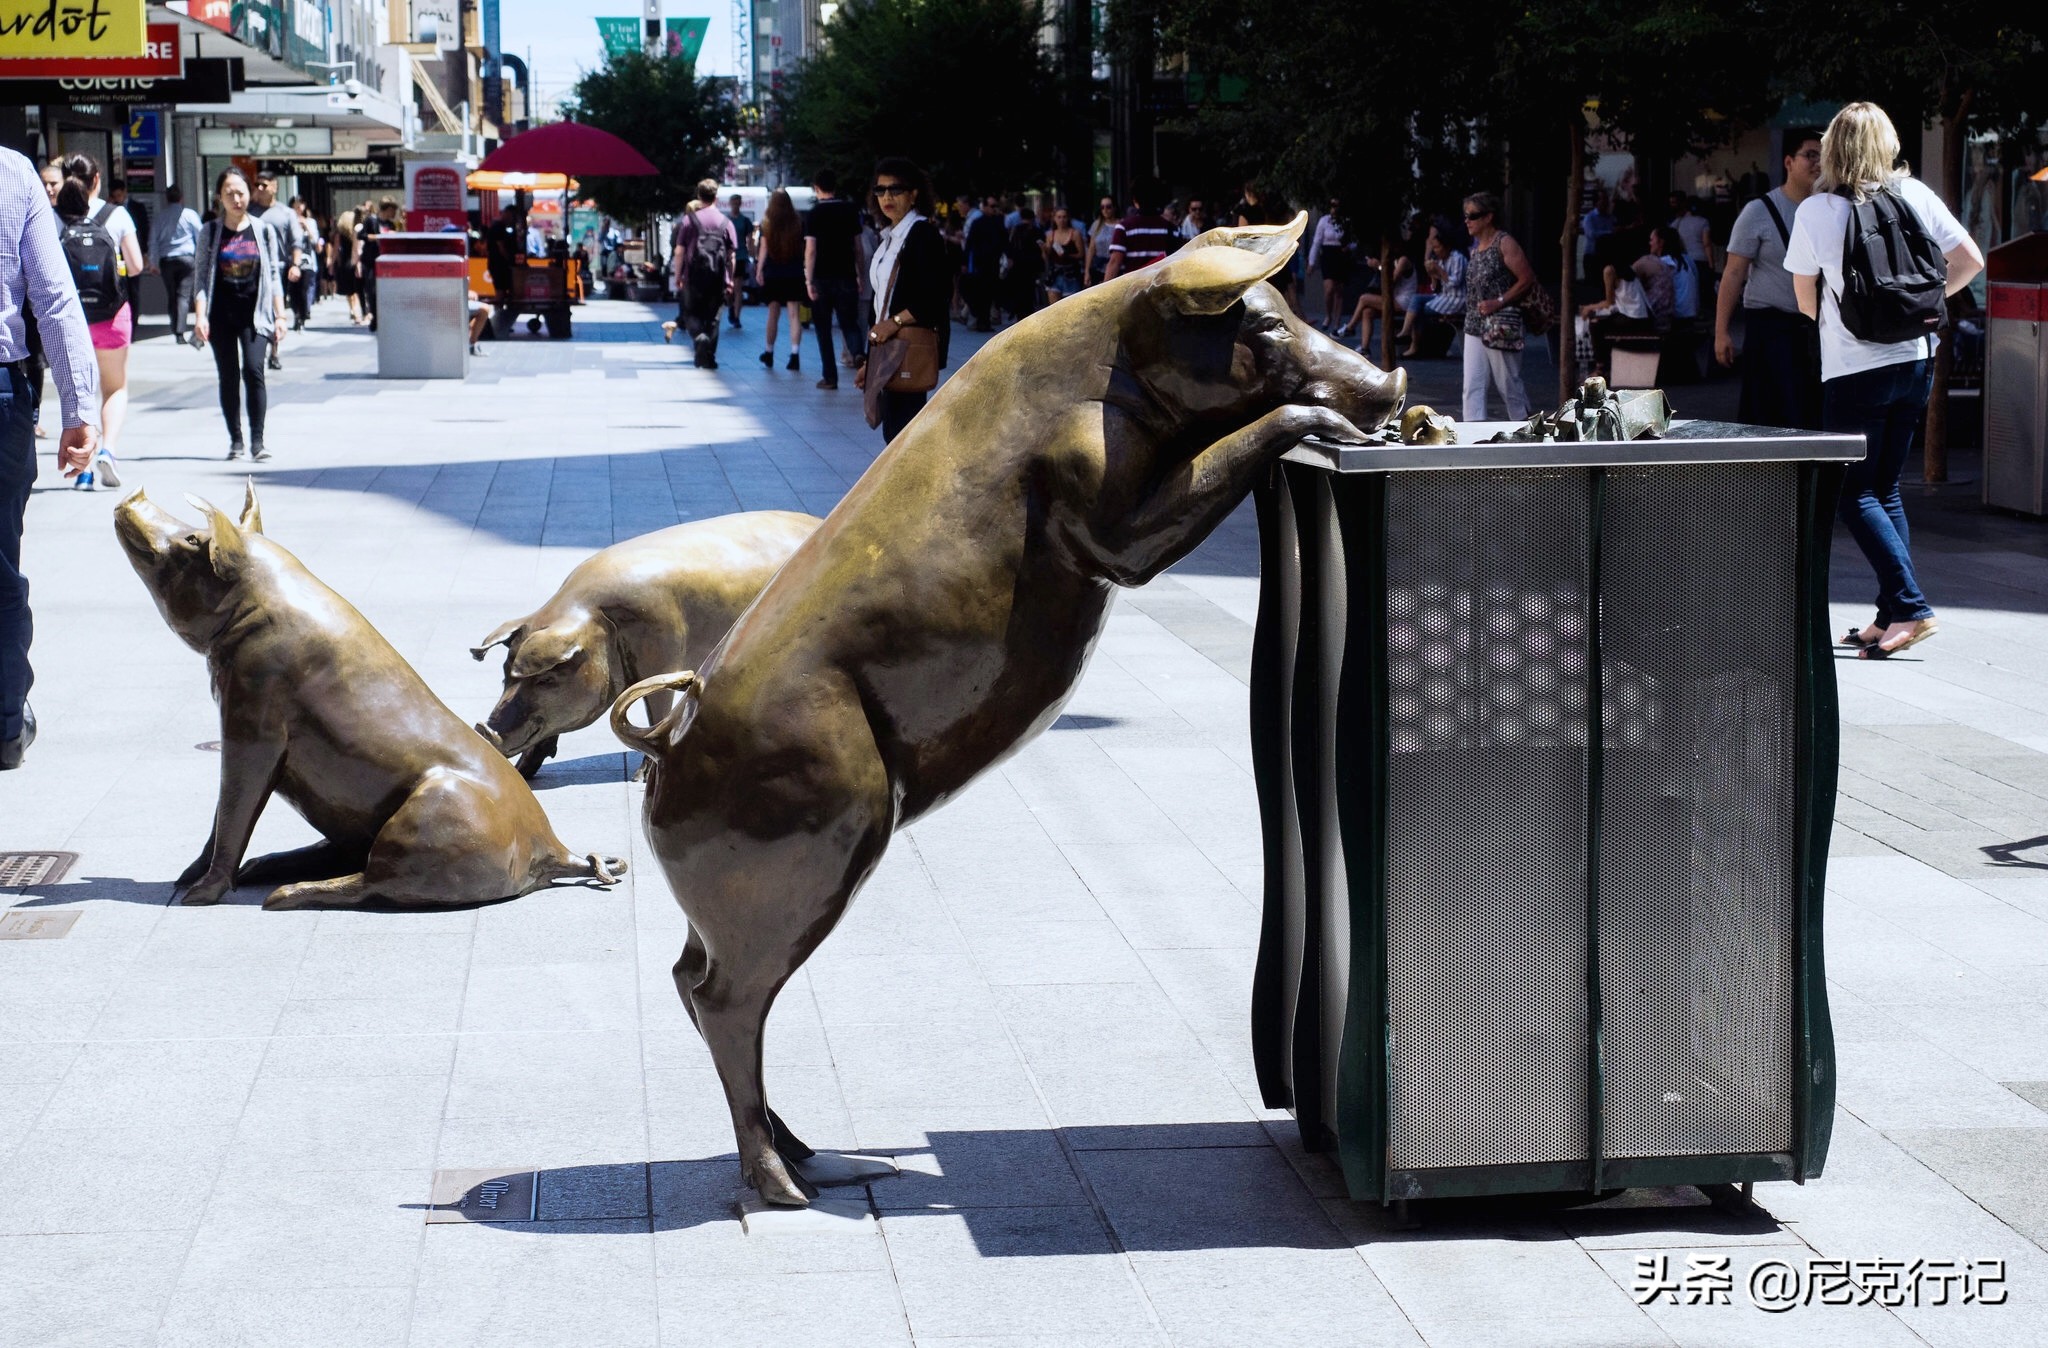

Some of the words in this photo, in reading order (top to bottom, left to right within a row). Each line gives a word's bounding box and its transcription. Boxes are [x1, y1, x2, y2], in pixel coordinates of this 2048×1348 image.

[231, 128, 297, 153] Typo
[293, 163, 329, 173] TRAVEL
[331, 163, 366, 173] MONEY
[479, 1181, 509, 1209] Oliver
